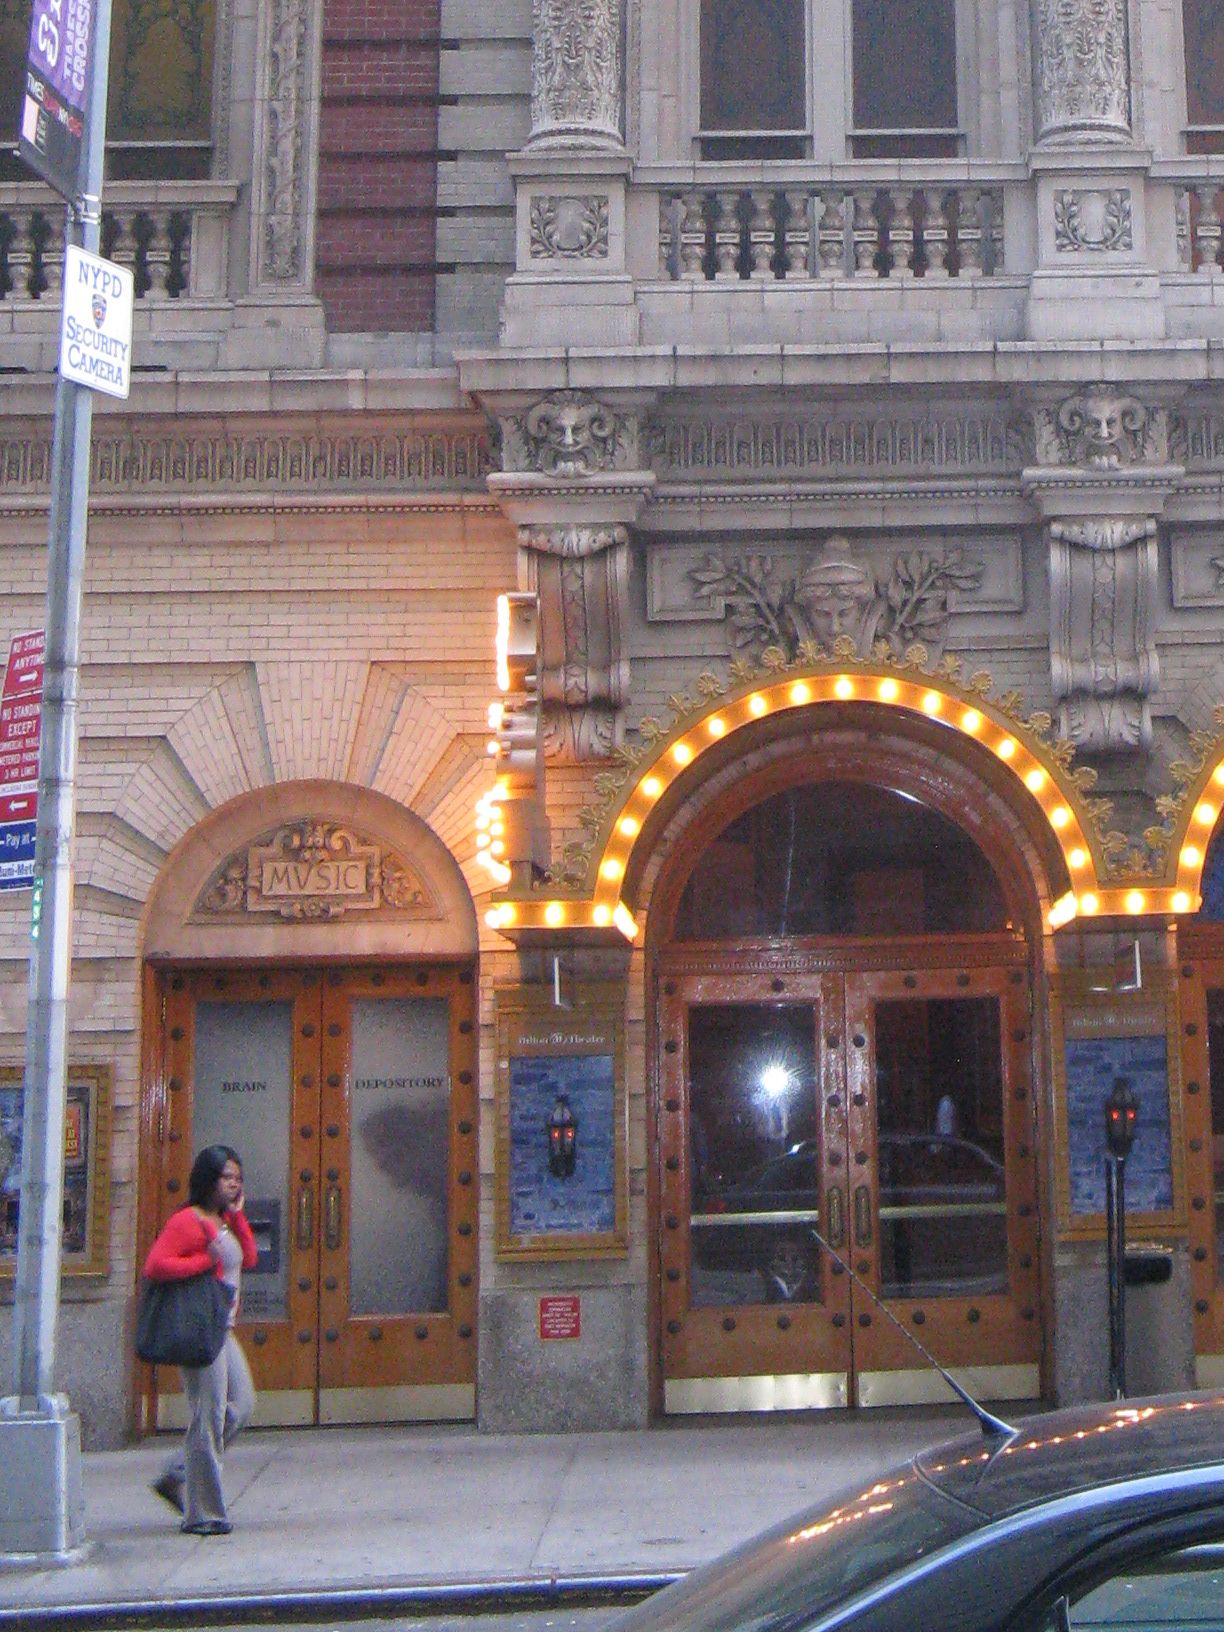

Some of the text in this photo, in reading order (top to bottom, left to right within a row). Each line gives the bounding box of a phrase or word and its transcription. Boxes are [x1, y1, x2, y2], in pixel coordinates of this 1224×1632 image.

[78, 259, 123, 299] NYPD
[66, 315, 128, 361] SECURITY
[68, 343, 124, 387] CAMERA
[13, 641, 22, 654] NO
[2, 702, 41, 721] NO STANDIN
[9, 720, 37, 737] EXCEPT
[20, 765, 36, 777] LIMIT
[6, 832, 30, 849] Pay at
[222, 1080, 268, 1093] BRAIN
[354, 1076, 444, 1090] DEPOSITORY
